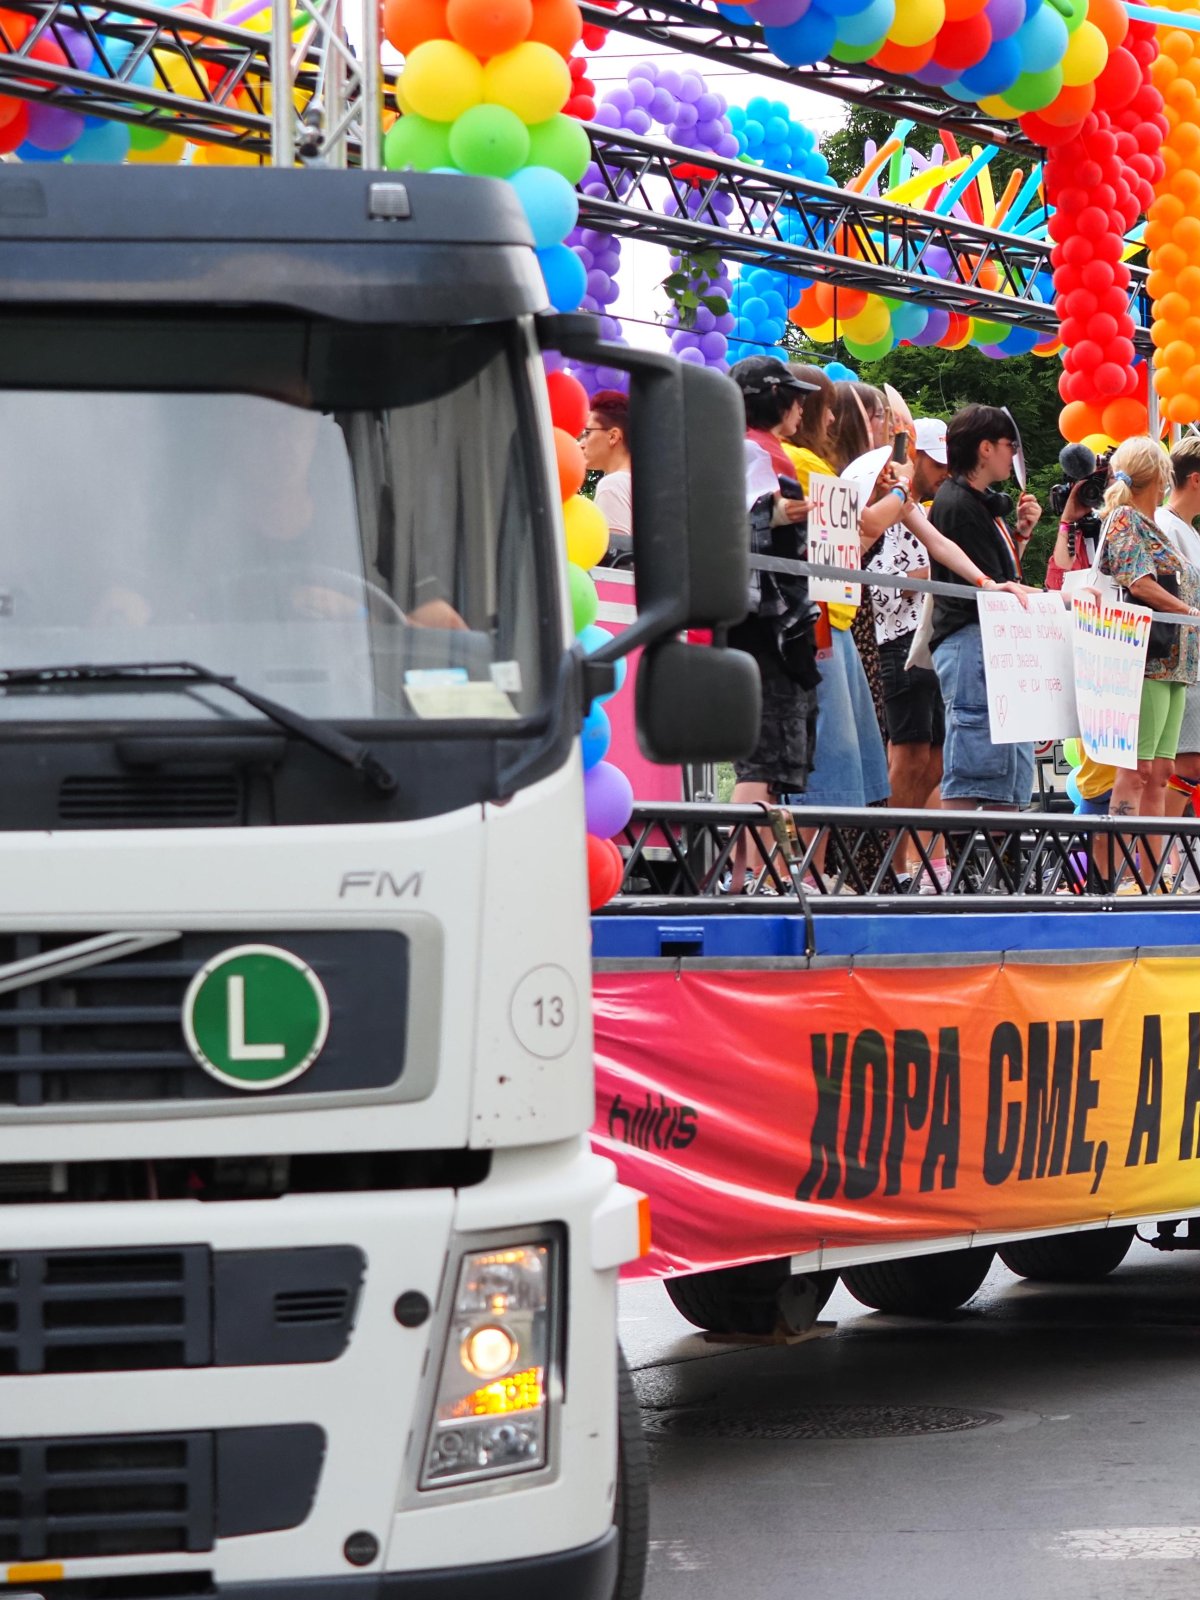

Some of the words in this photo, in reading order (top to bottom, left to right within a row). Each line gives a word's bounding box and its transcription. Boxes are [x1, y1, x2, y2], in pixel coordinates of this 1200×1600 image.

[339, 871, 424, 898] FM
[226, 975, 286, 1061] L
[533, 996, 565, 1027] 13
[795, 1027, 960, 1200] ХОРА
[982, 1018, 1108, 1194] СМЕ,
[1125, 1014, 1163, 1167] А
